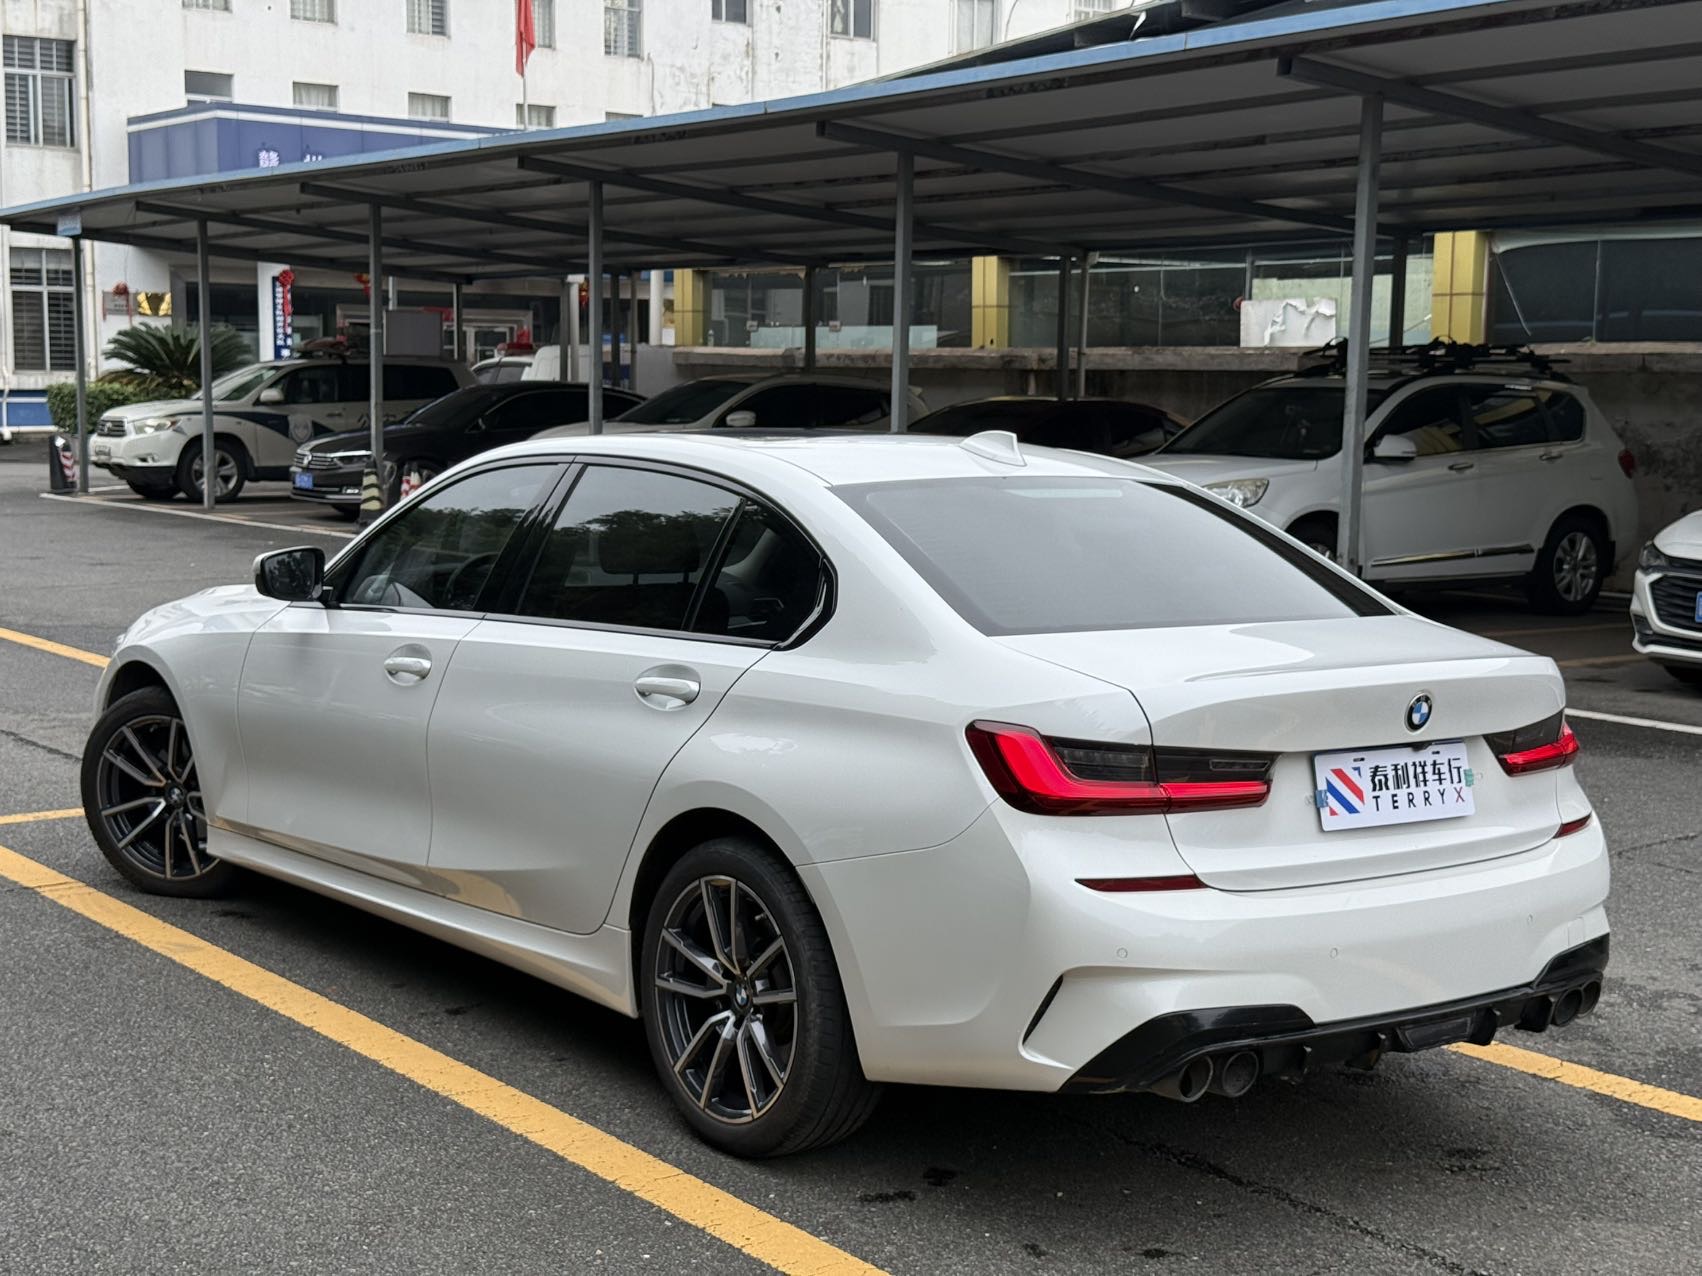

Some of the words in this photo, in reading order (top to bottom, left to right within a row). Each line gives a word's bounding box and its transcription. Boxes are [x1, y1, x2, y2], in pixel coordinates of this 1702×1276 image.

[1369, 757, 1463, 792] 泰利祥车行
